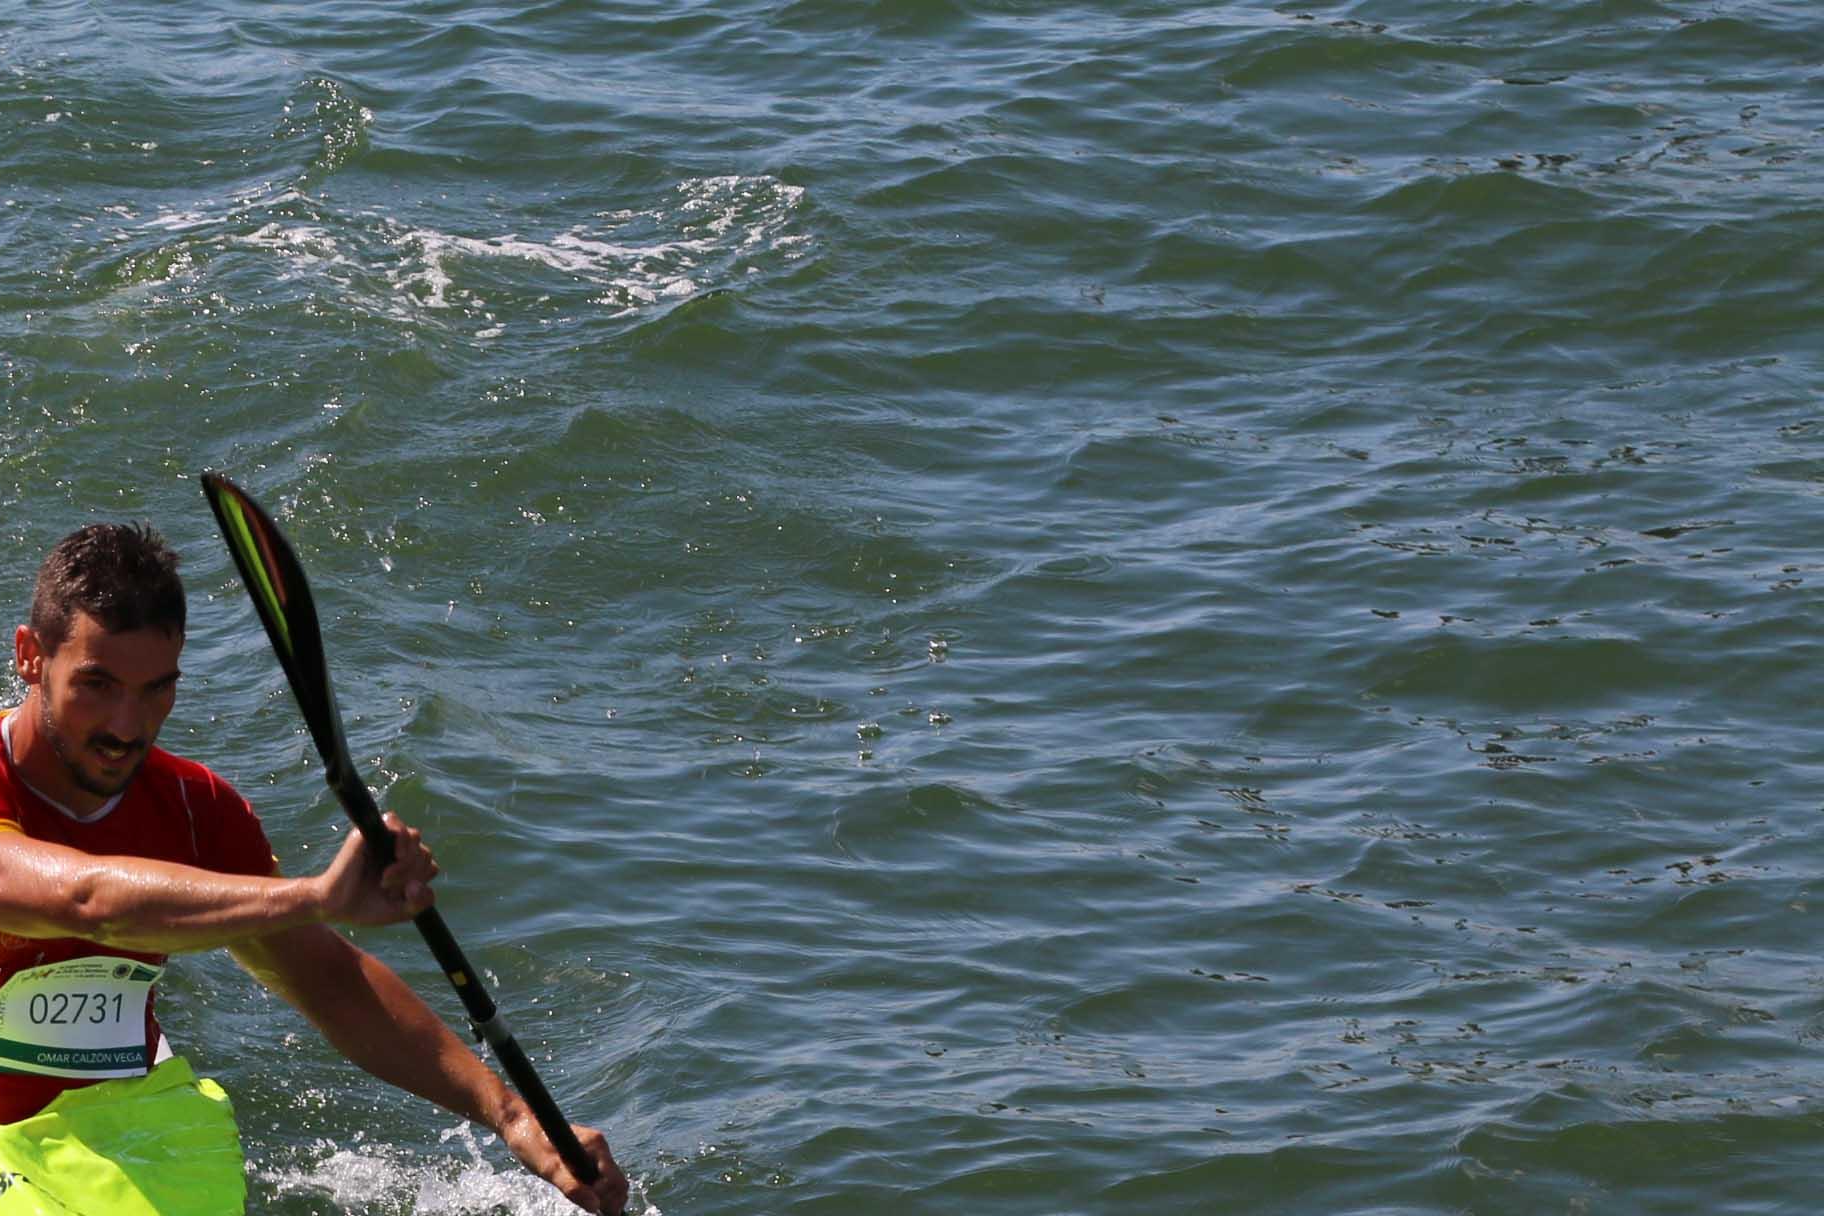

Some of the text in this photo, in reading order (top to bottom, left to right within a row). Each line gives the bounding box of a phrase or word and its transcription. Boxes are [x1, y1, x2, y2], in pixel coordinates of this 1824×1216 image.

[29, 993, 122, 1024] 02731
[37, 1052, 144, 1063] OMAR CALZON VEGA
